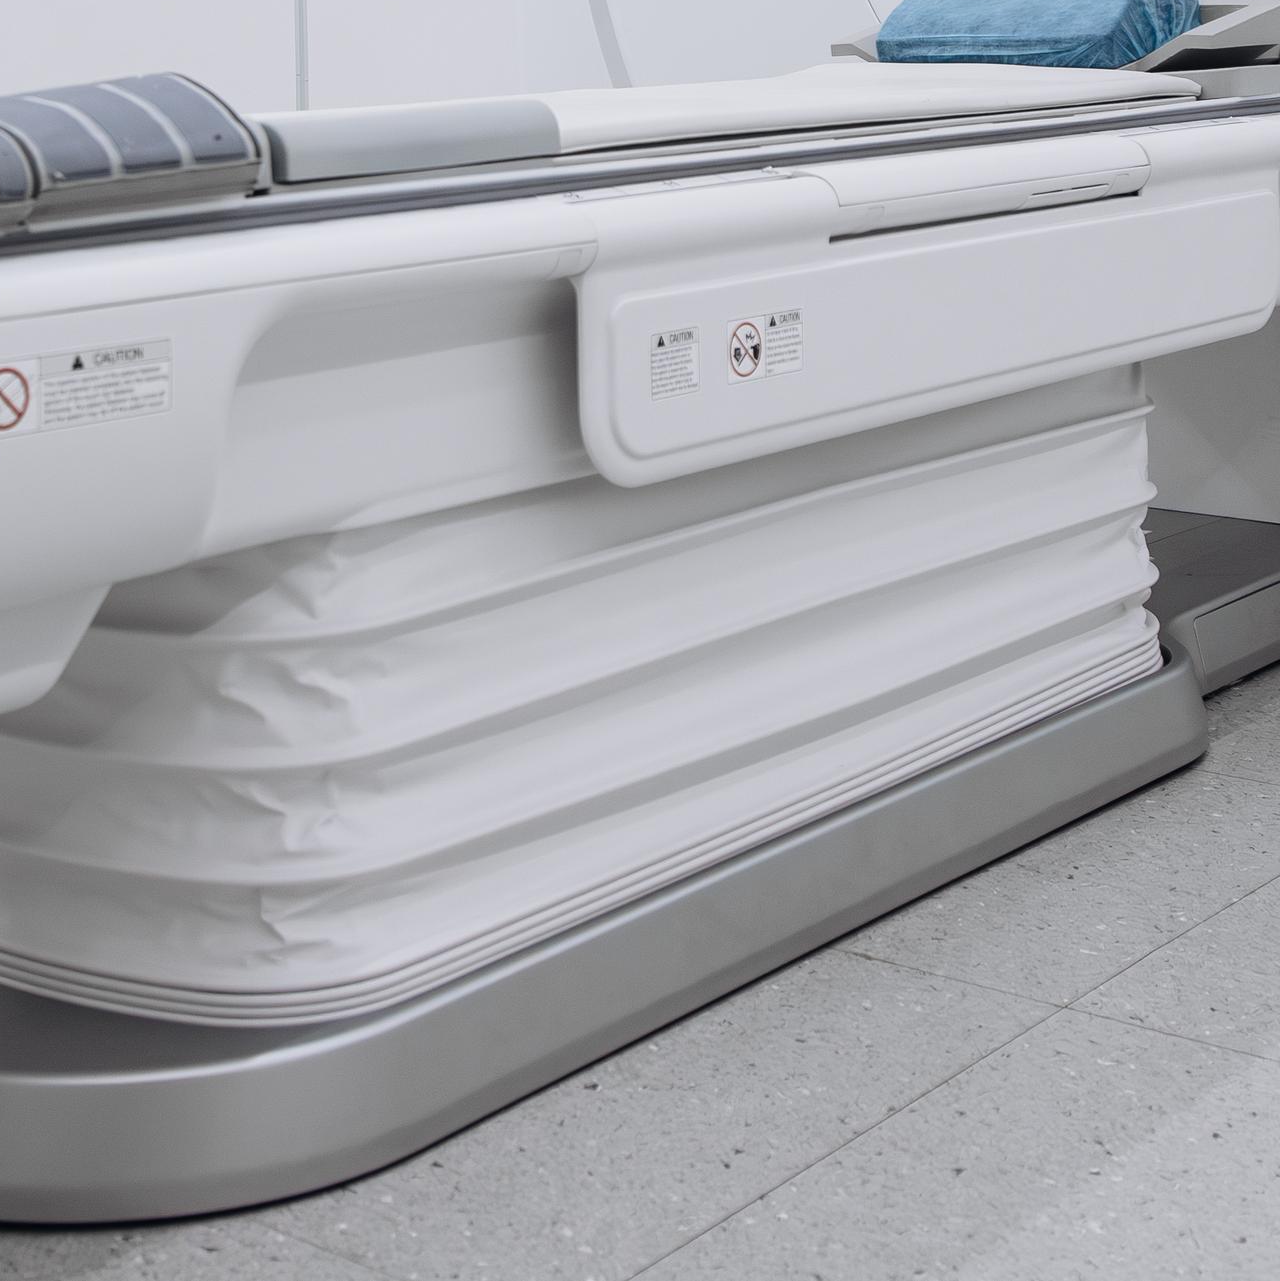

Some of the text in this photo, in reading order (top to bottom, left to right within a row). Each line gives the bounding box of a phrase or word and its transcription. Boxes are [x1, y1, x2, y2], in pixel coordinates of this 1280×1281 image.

[778, 312, 801, 324] CAUTION
[669, 330, 694, 344] CAUTION
[94, 346, 145, 366] CAUTION
